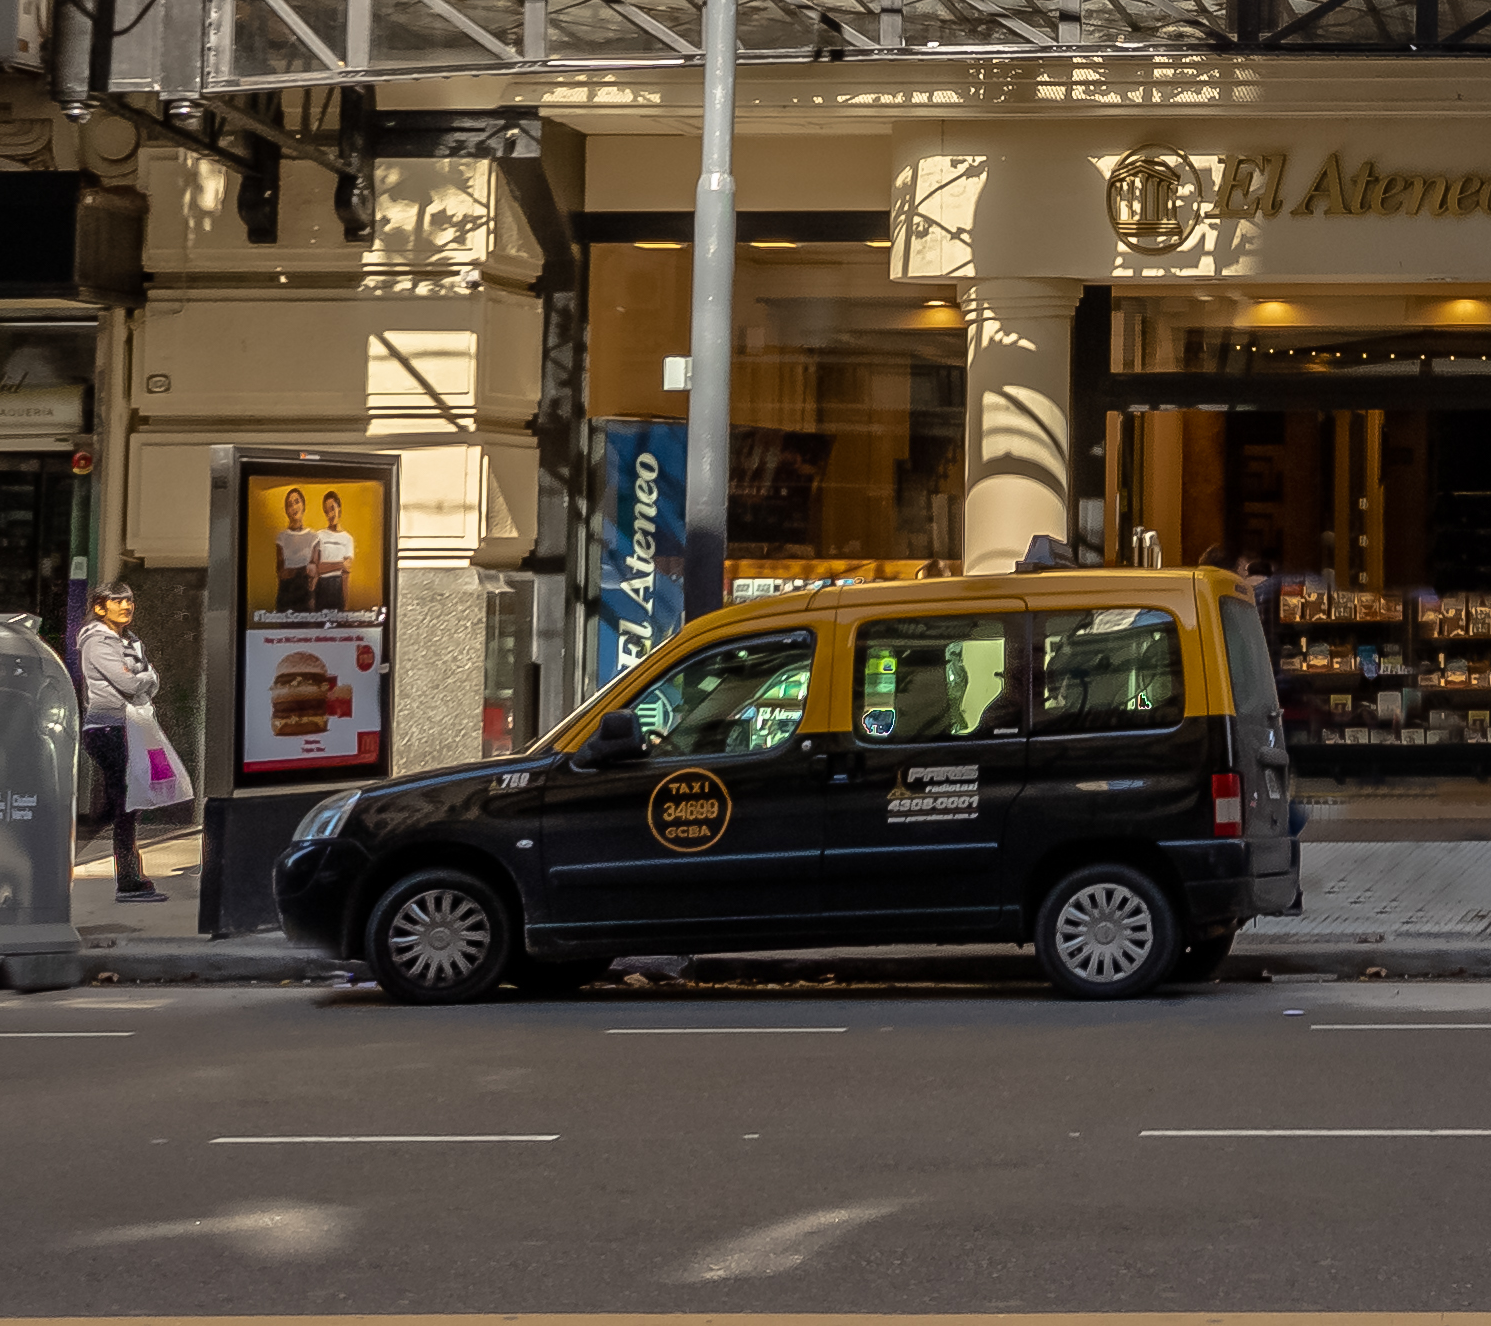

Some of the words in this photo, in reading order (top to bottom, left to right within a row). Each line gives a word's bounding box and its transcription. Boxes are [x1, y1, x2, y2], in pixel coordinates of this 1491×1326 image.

[1206, 151, 1288, 220] El
[620, 452, 659, 616] Ateneo
[617, 619, 653, 671] El
[907, 765, 979, 783] PARIS
[668, 781, 710, 795] TAXI
[925, 781, 978, 793] radiotaxi
[888, 795, 979, 811] 4308-0001
[665, 825, 712, 838] GCBA
